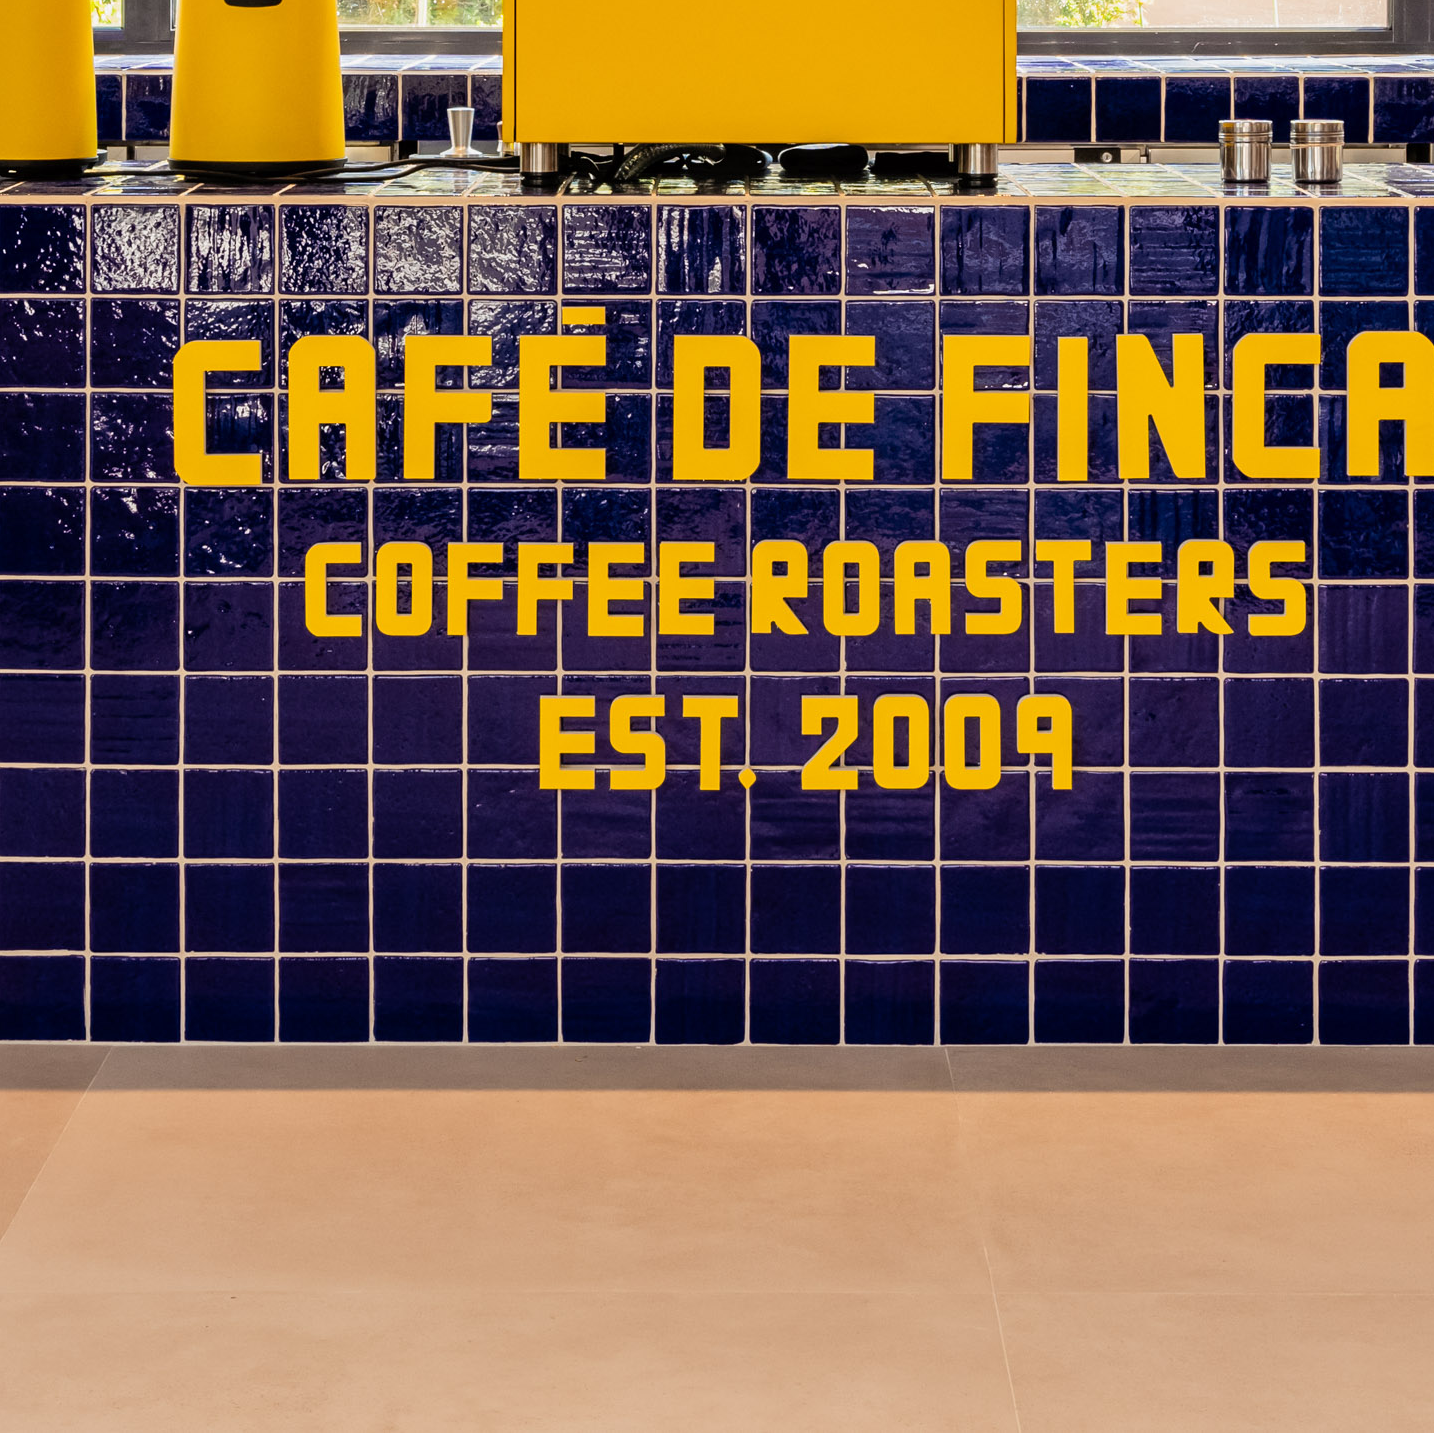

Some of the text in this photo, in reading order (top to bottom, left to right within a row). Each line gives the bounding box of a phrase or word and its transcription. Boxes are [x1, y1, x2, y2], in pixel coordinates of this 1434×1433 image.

[172, 307, 607, 487] CAFÉ
[672, 335, 876, 482] DE
[304, 540, 1307, 638] COFFEE ROASTERS
[539, 695, 1074, 792] EST. 2009
